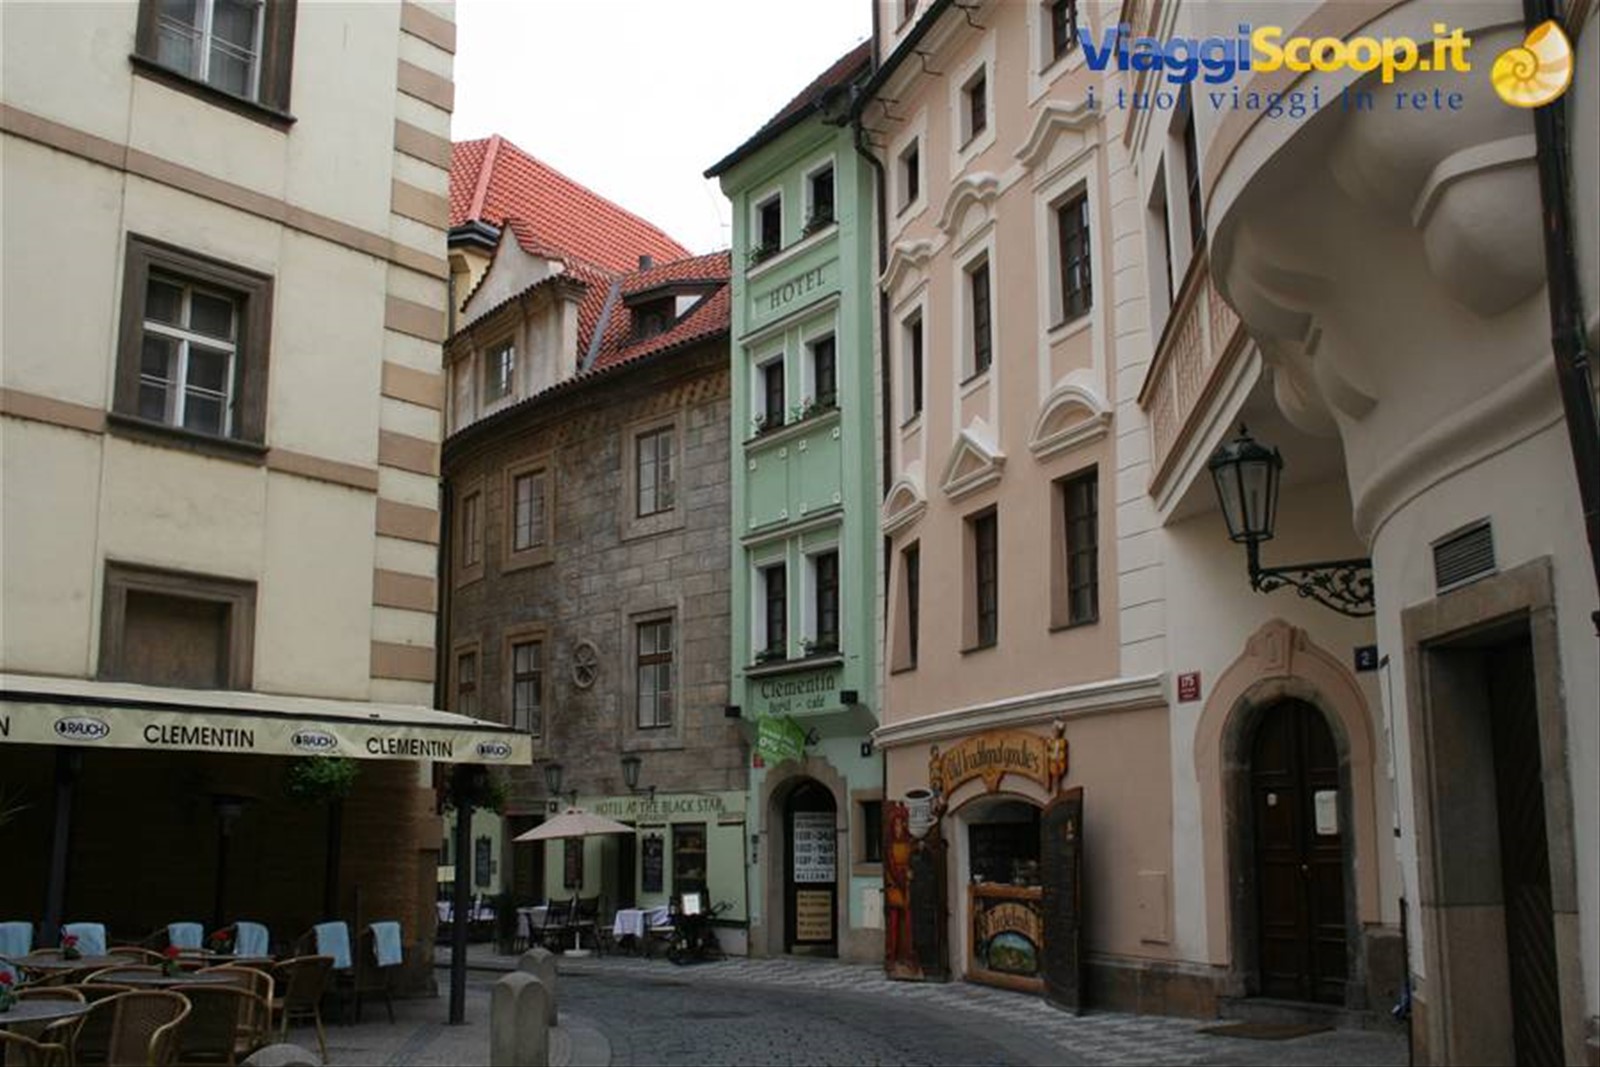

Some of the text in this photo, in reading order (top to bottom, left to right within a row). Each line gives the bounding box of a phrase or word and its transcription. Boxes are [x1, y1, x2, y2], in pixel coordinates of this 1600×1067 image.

[769, 267, 825, 310] HOTEL
[761, 673, 835, 699] Clementin
[66, 722, 104, 735] RAUCH
[143, 724, 254, 748] CLEMENTIN
[366, 736, 453, 758] CLEMENTIN
[640, 800, 658, 814] THE
[661, 799, 694, 813] BLACK
